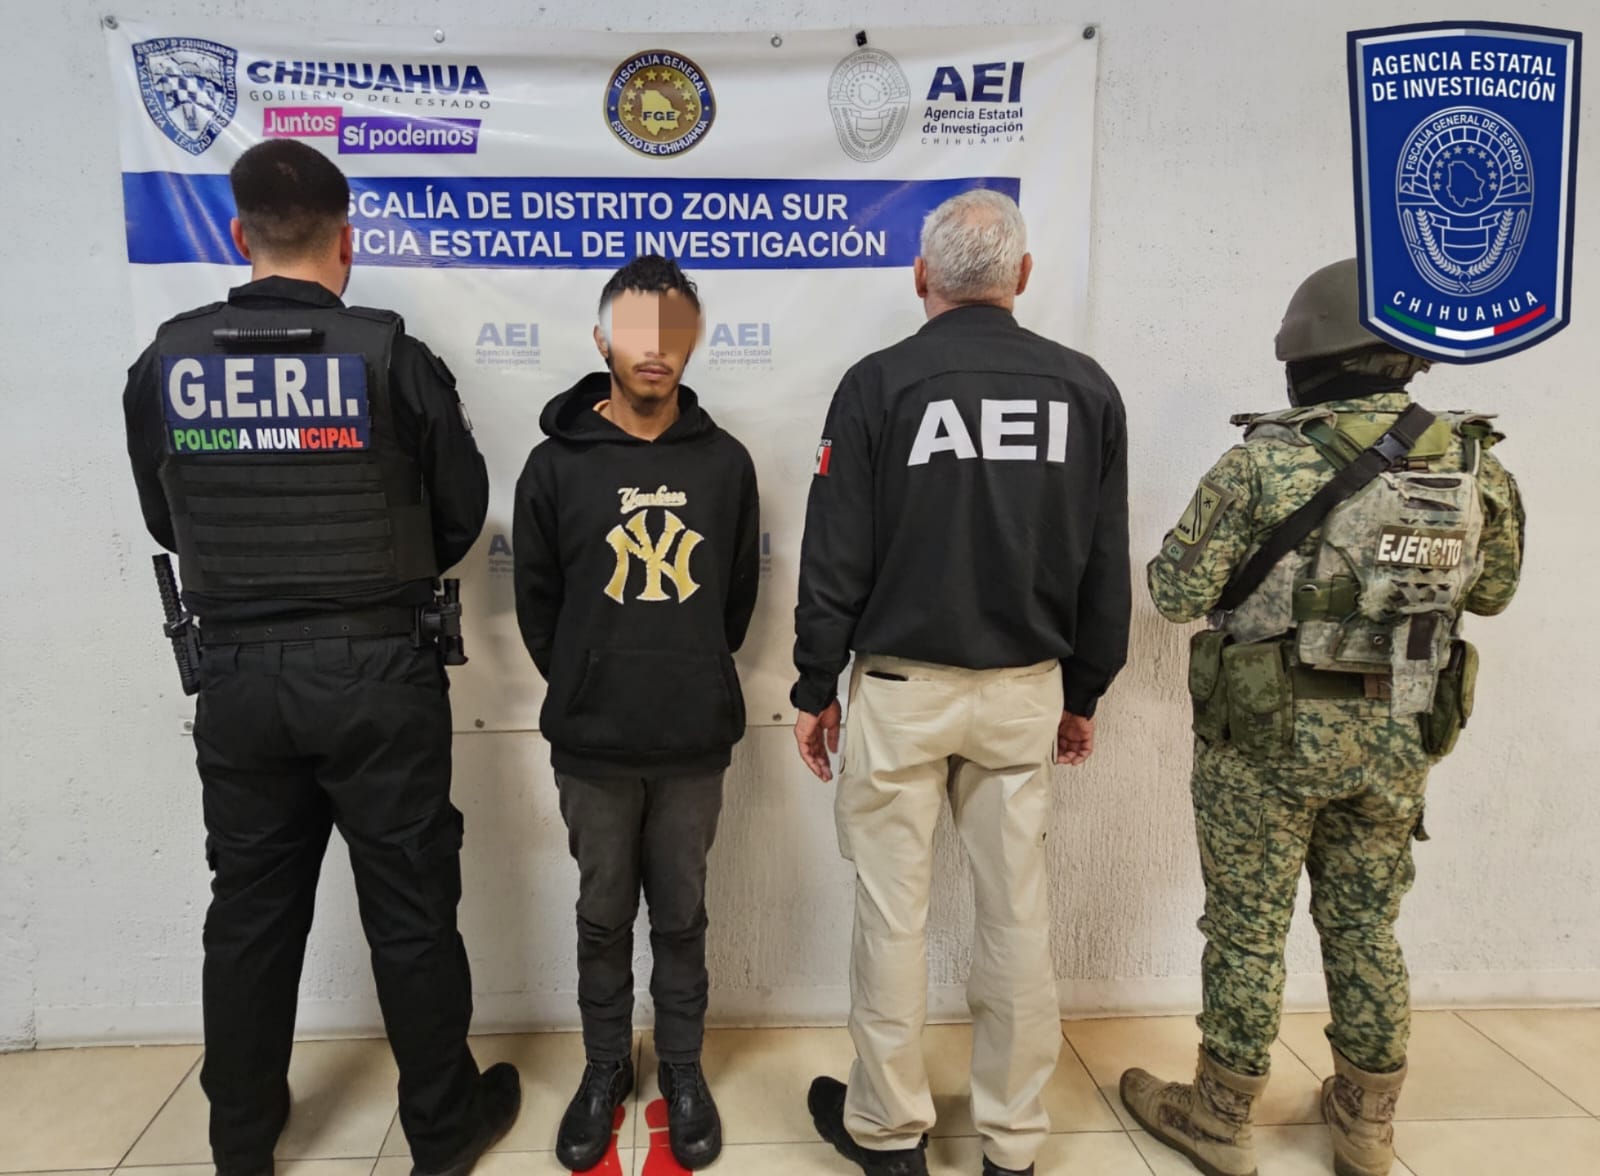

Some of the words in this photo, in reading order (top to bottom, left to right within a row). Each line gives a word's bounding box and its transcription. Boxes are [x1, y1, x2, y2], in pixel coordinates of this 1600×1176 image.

[246, 60, 490, 95] CHIHUAHUA
[662, 55, 707, 96] GENERAL
[926, 62, 1025, 103] AEI
[249, 90, 355, 102] GOBIERNO
[367, 94, 402, 104] DEL
[414, 97, 491, 110] ESTADO
[923, 106, 975, 121] Agencia
[978, 107, 1023, 120] Estatal
[266, 110, 337, 132] Juntos
[643, 111, 676, 121] FGE
[922, 121, 938, 134] de
[941, 122, 1023, 137] Investigación
[343, 122, 368, 146] Sí
[369, 124, 475, 150] podemos
[611, 119, 643, 149] ESTADO
[642, 143, 658, 155] DE
[658, 119, 709, 155] CHIHUAHUA
[921, 135, 1025, 145] CHIHUAHUA
[467, 192, 512, 219] DE
[522, 191, 673, 220] DISTRITO
[682, 192, 774, 221] ZONA
[782, 193, 848, 220] SUR
[430, 230, 572, 258] ESTATAL
[582, 230, 625, 258] DE
[636, 226, 886, 258] INVESTIGACIÓN
[475, 322, 539, 347] AEI
[708, 323, 771, 347] AEI
[168, 357, 360, 420] G.E.R.I.
[173, 428, 252, 451] POLICIA
[256, 426, 364, 450] MUNICIPAL
[907, 398, 1069, 466] AEI
[1378, 529, 1463, 567] EJÉRCITO
